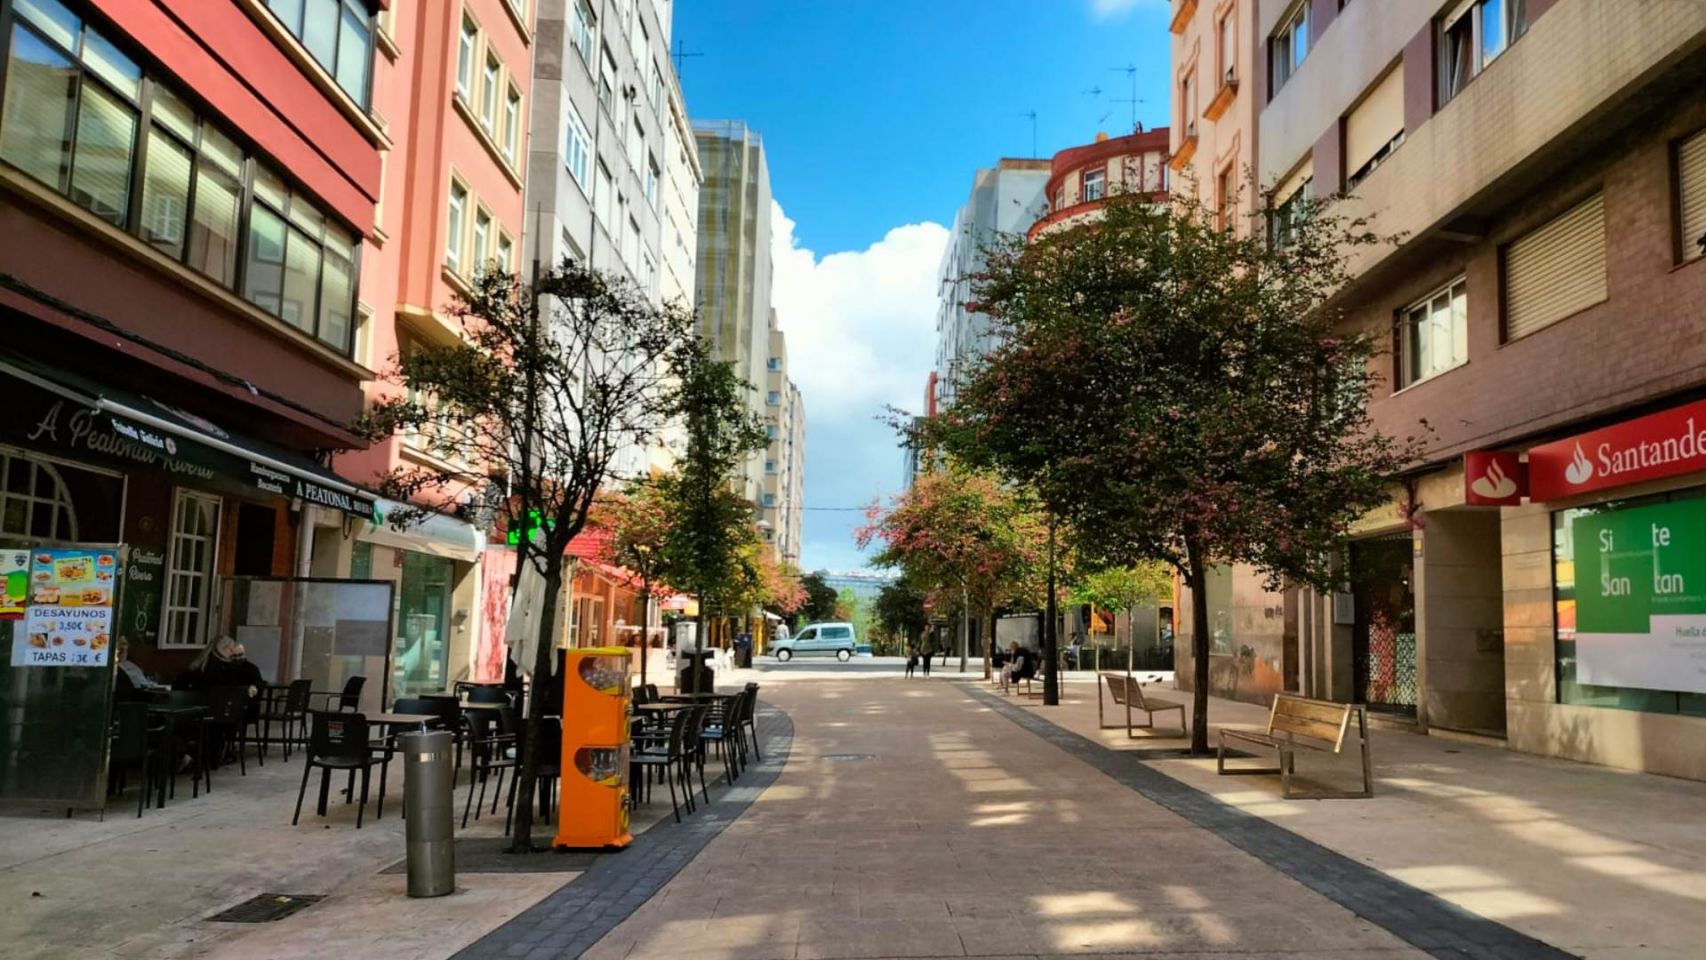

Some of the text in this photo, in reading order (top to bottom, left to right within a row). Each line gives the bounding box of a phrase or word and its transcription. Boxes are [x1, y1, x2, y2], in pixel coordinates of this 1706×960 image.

[27, 400, 58, 442] A
[1598, 417, 1706, 477] Santande
[296, 482, 304, 498] A
[305, 483, 352, 511] PEATONAL
[1599, 522, 1671, 553] Si te
[1601, 572, 1684, 596] San tan
[34, 608, 106, 619] DESAYUNOS
[33, 652, 67, 663] TAPAS
